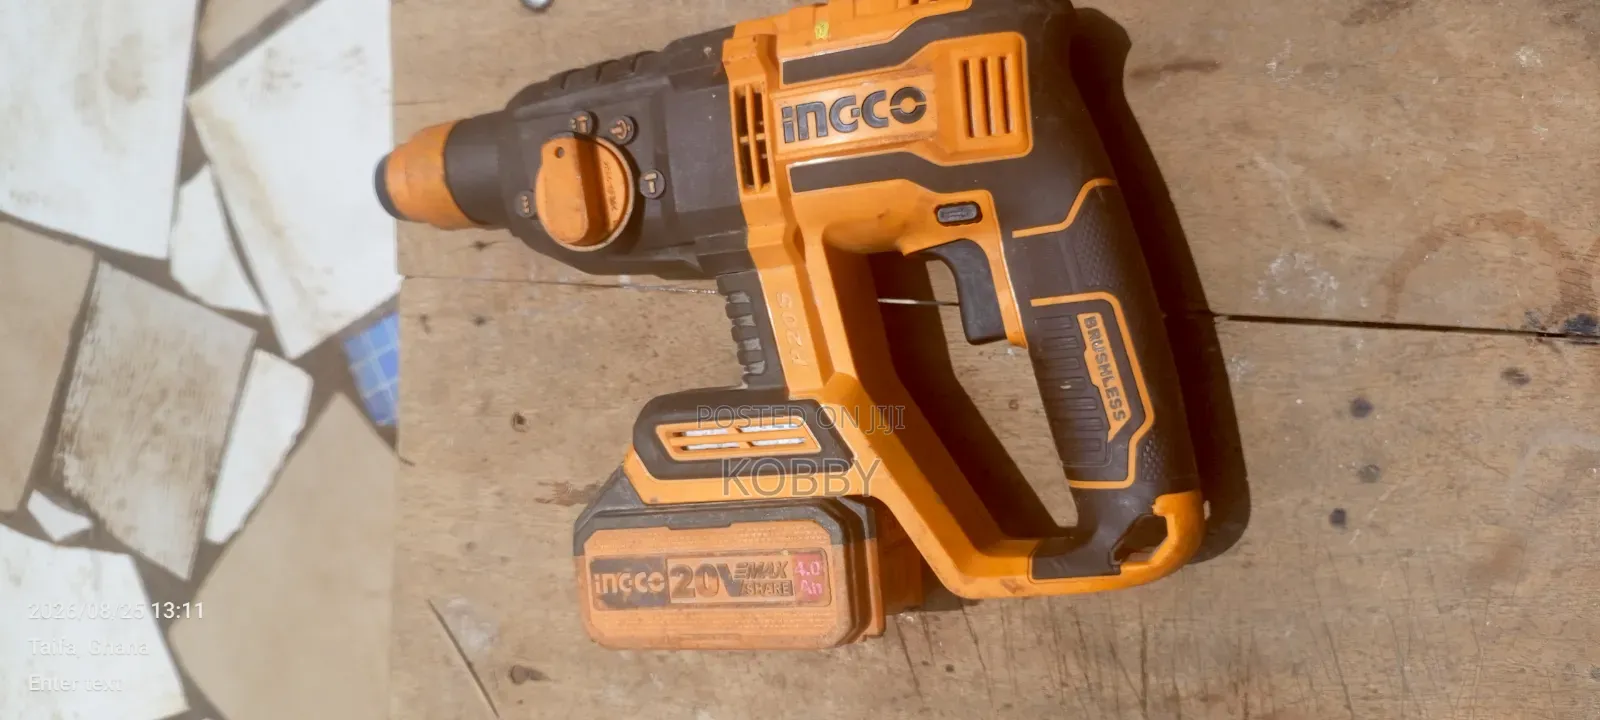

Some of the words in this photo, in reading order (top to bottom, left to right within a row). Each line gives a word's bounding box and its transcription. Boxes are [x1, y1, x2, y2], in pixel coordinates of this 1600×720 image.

[1083, 315, 1126, 422] BRUSHLESS
[795, 562, 820, 576] 4.0
[745, 581, 790, 596] SHARE
